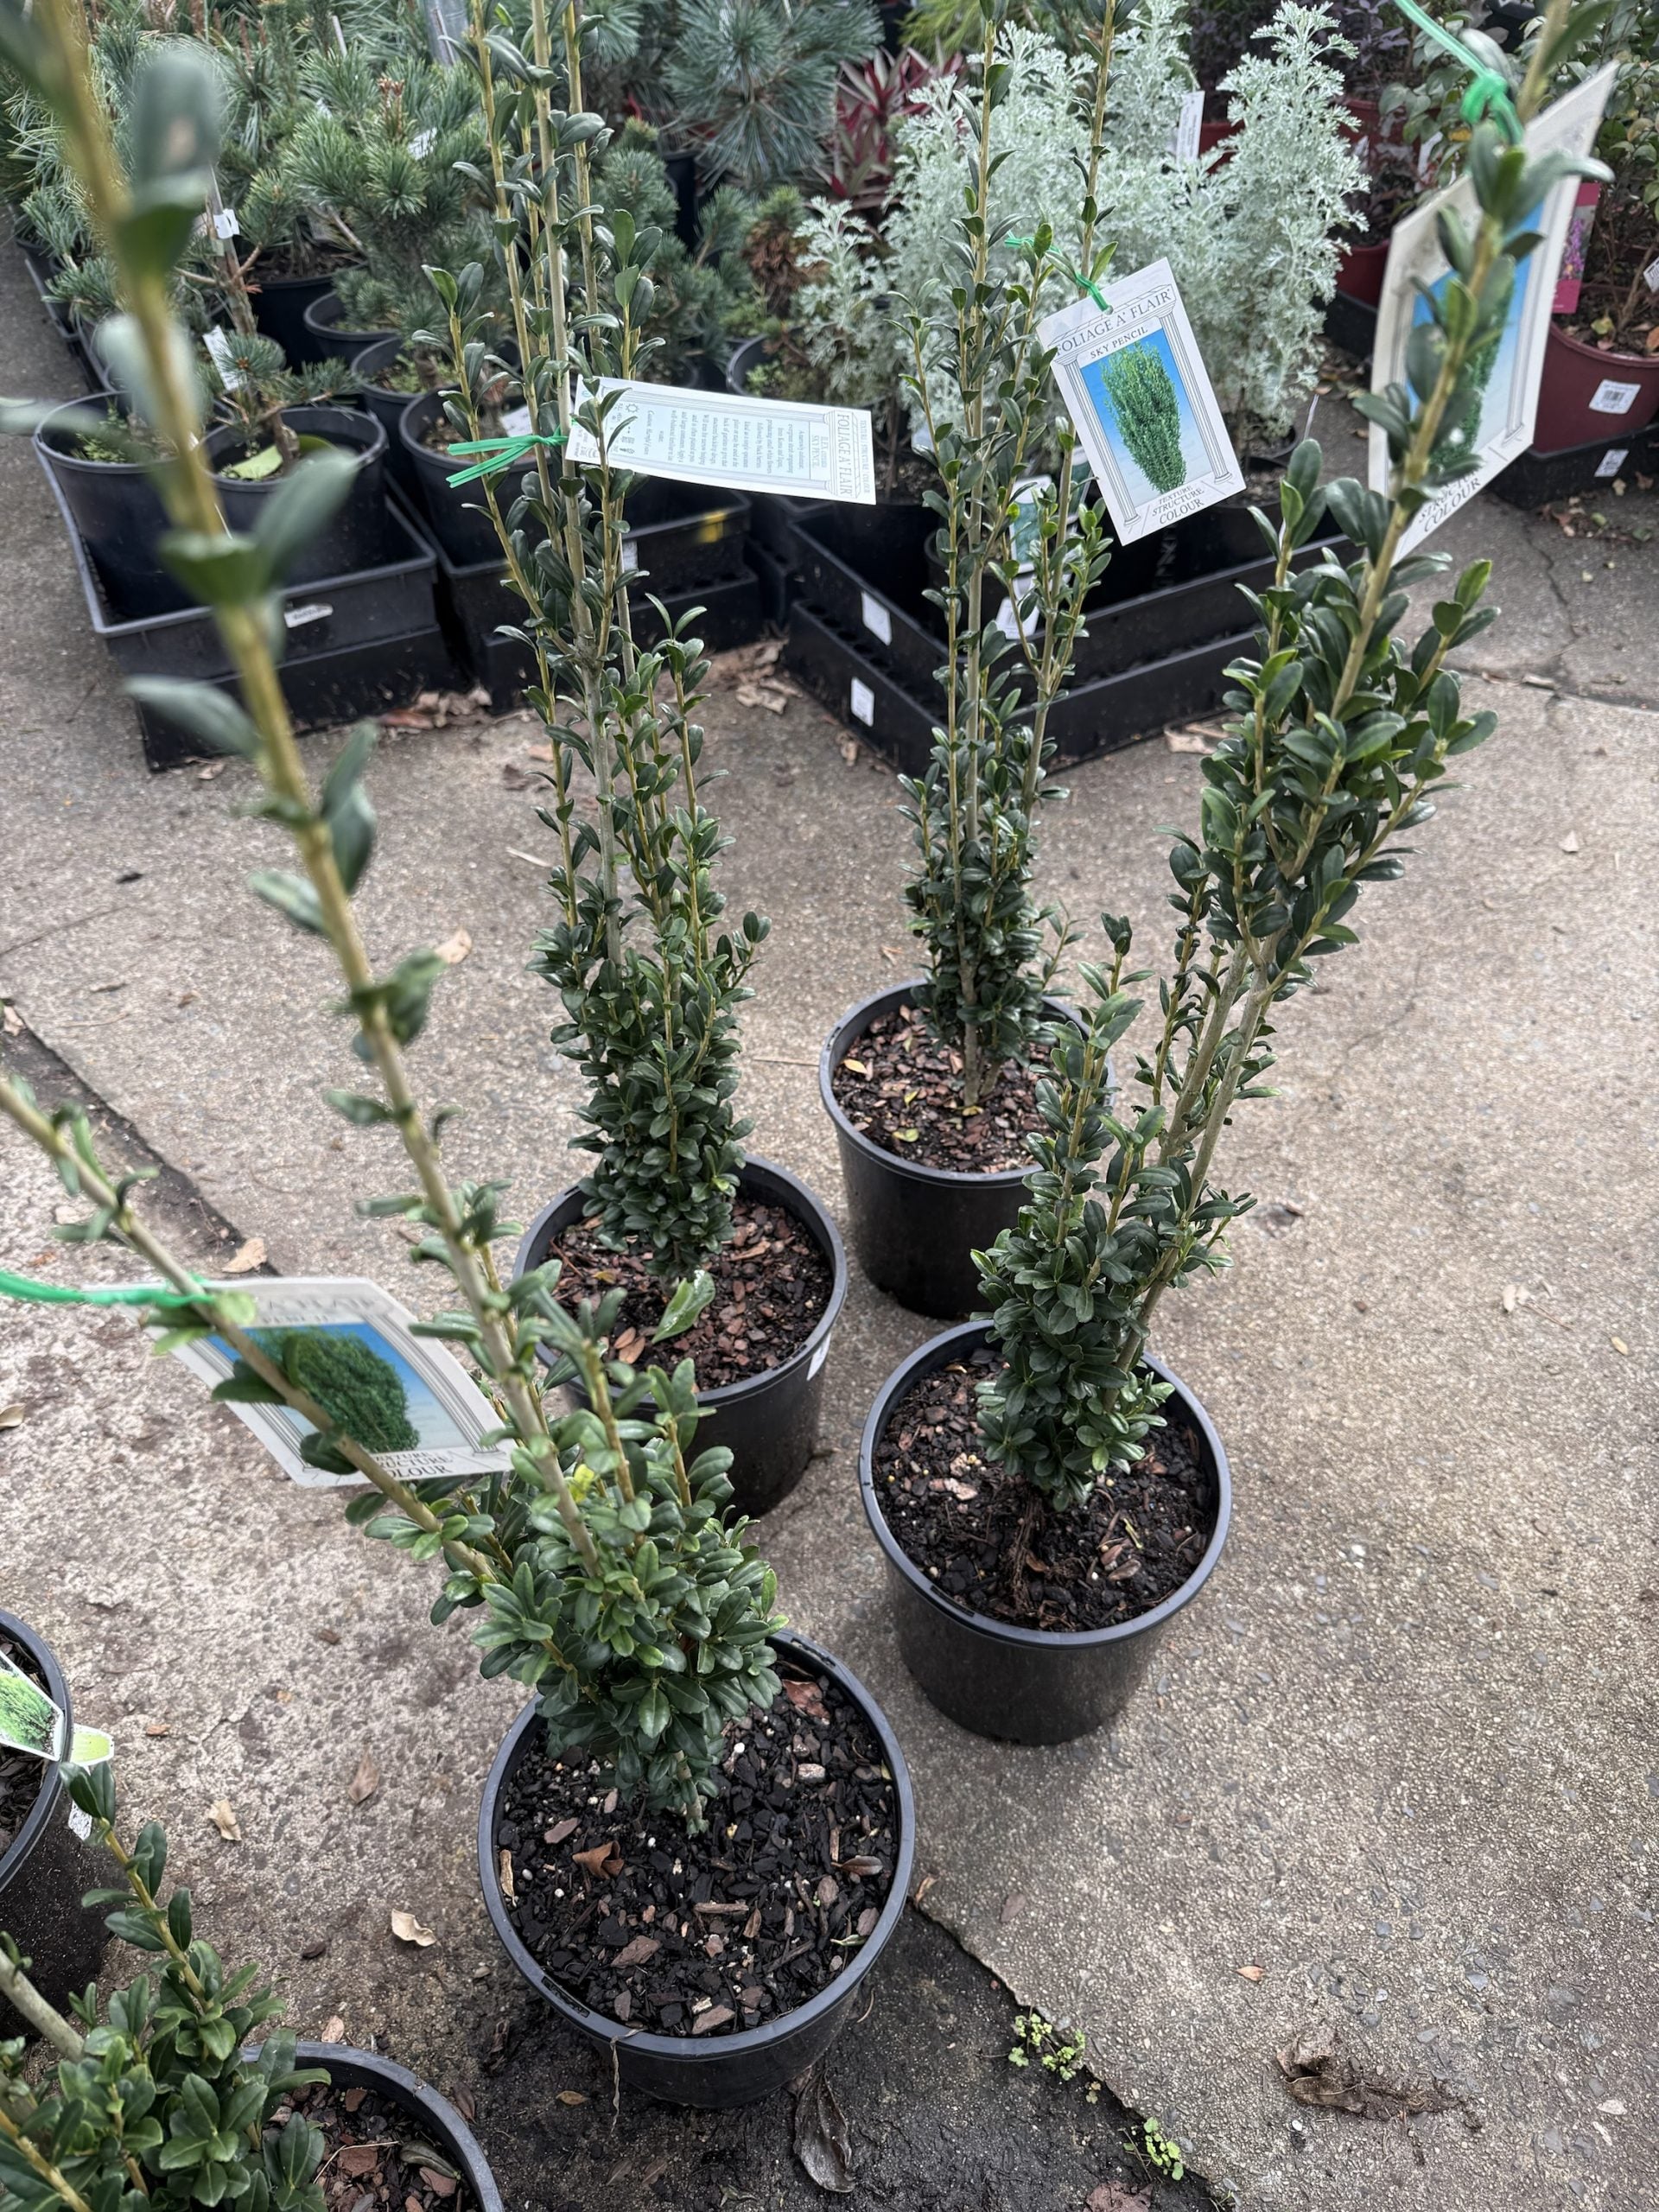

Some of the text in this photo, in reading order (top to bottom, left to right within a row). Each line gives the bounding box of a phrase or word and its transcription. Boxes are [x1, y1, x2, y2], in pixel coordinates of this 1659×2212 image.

[1090, 327, 1148, 359] SKY PENCIL
[837, 413, 850, 455] FOLIAGE
[838, 466, 852, 496] FLAIR
[1160, 486, 1192, 505] TEXTURE
[1419, 467, 1478, 524] STRUCT
[1152, 488, 1205, 517] STRUCTURE
[1160, 499, 1205, 524] COLOUR
[1424, 478, 1481, 532] COLOUR
[380, 1456, 453, 1468] UCTURE
